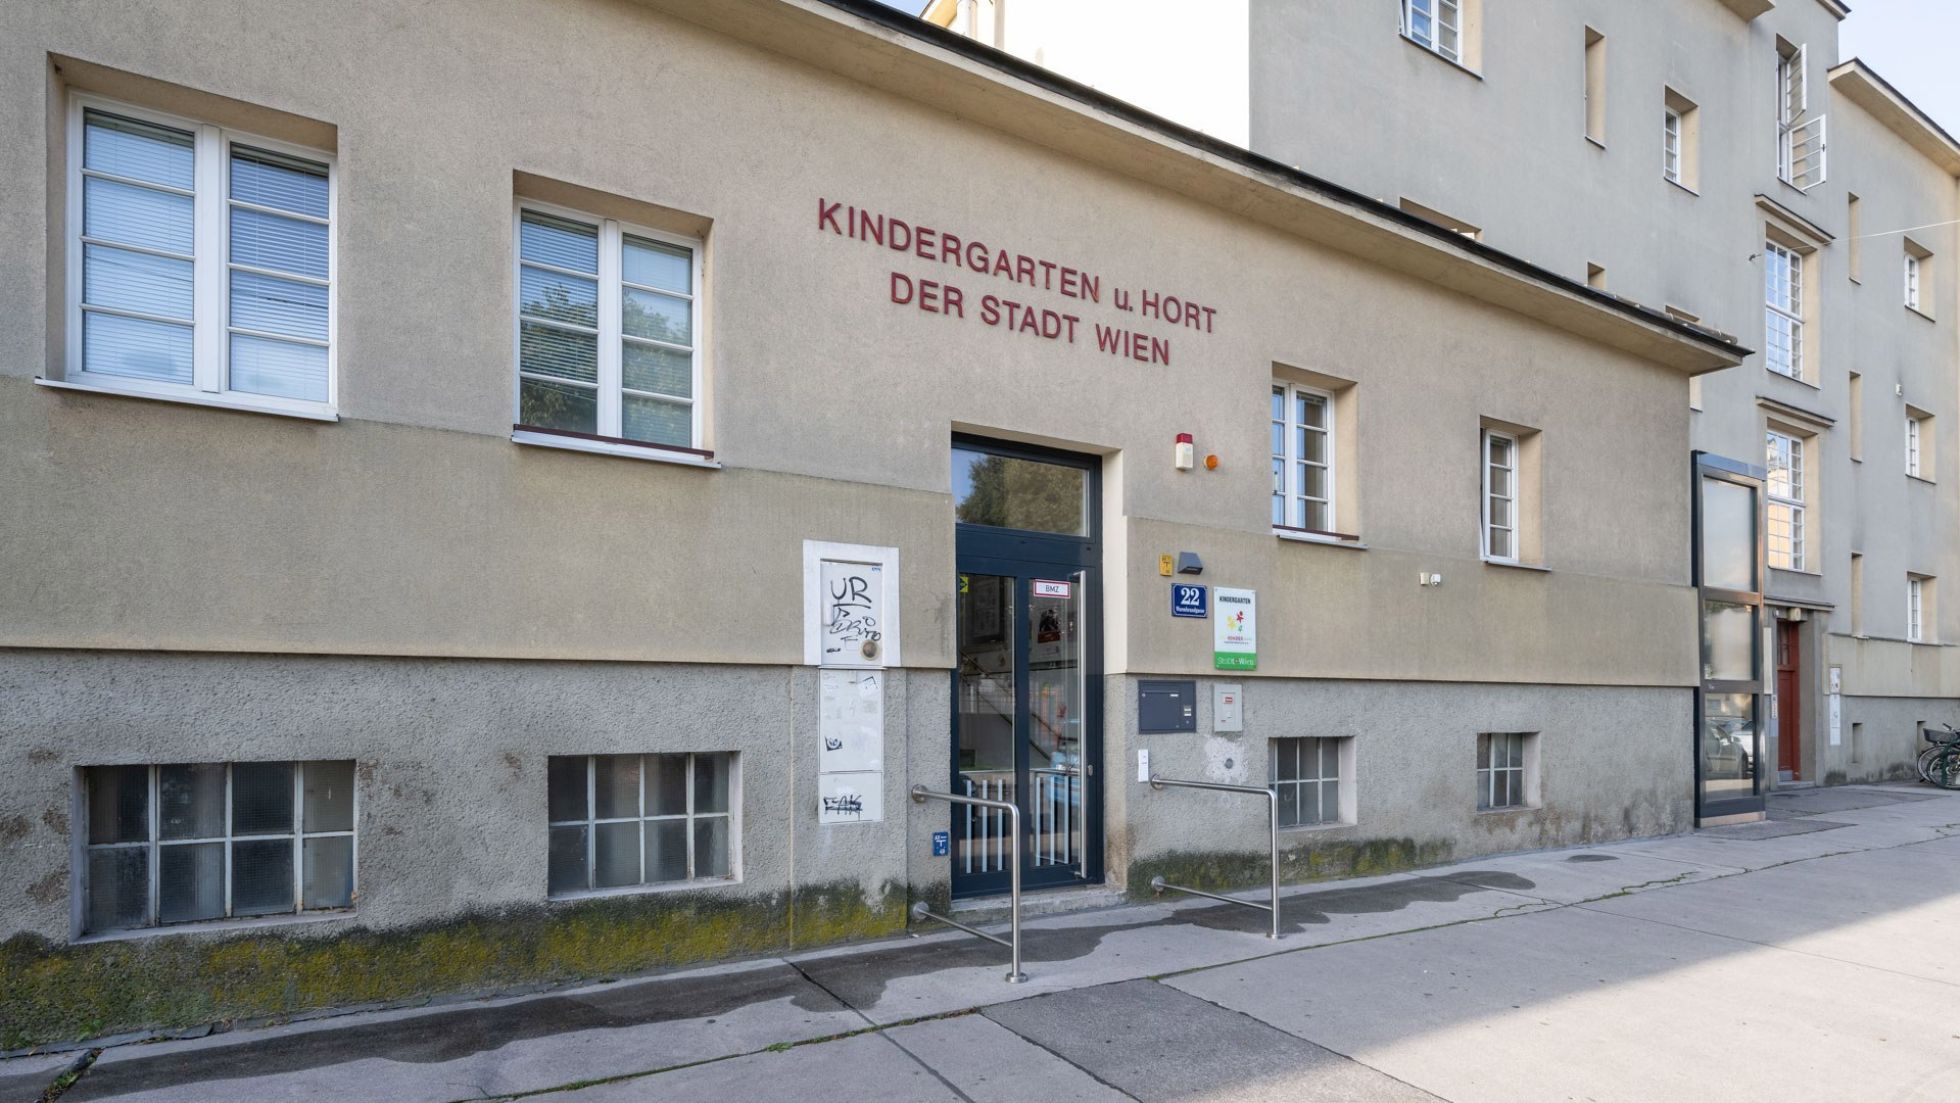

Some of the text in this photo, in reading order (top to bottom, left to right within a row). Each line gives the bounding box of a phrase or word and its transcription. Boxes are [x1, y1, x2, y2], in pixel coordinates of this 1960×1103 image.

[819, 198, 1217, 333] KINDERGARTEN u. HORT
[890, 272, 1170, 366] DER STADT WIEN
[1045, 585, 1060, 593] BMZ
[1180, 587, 1200, 605] 22
[1219, 596, 1251, 604] KINDERGARTEN
